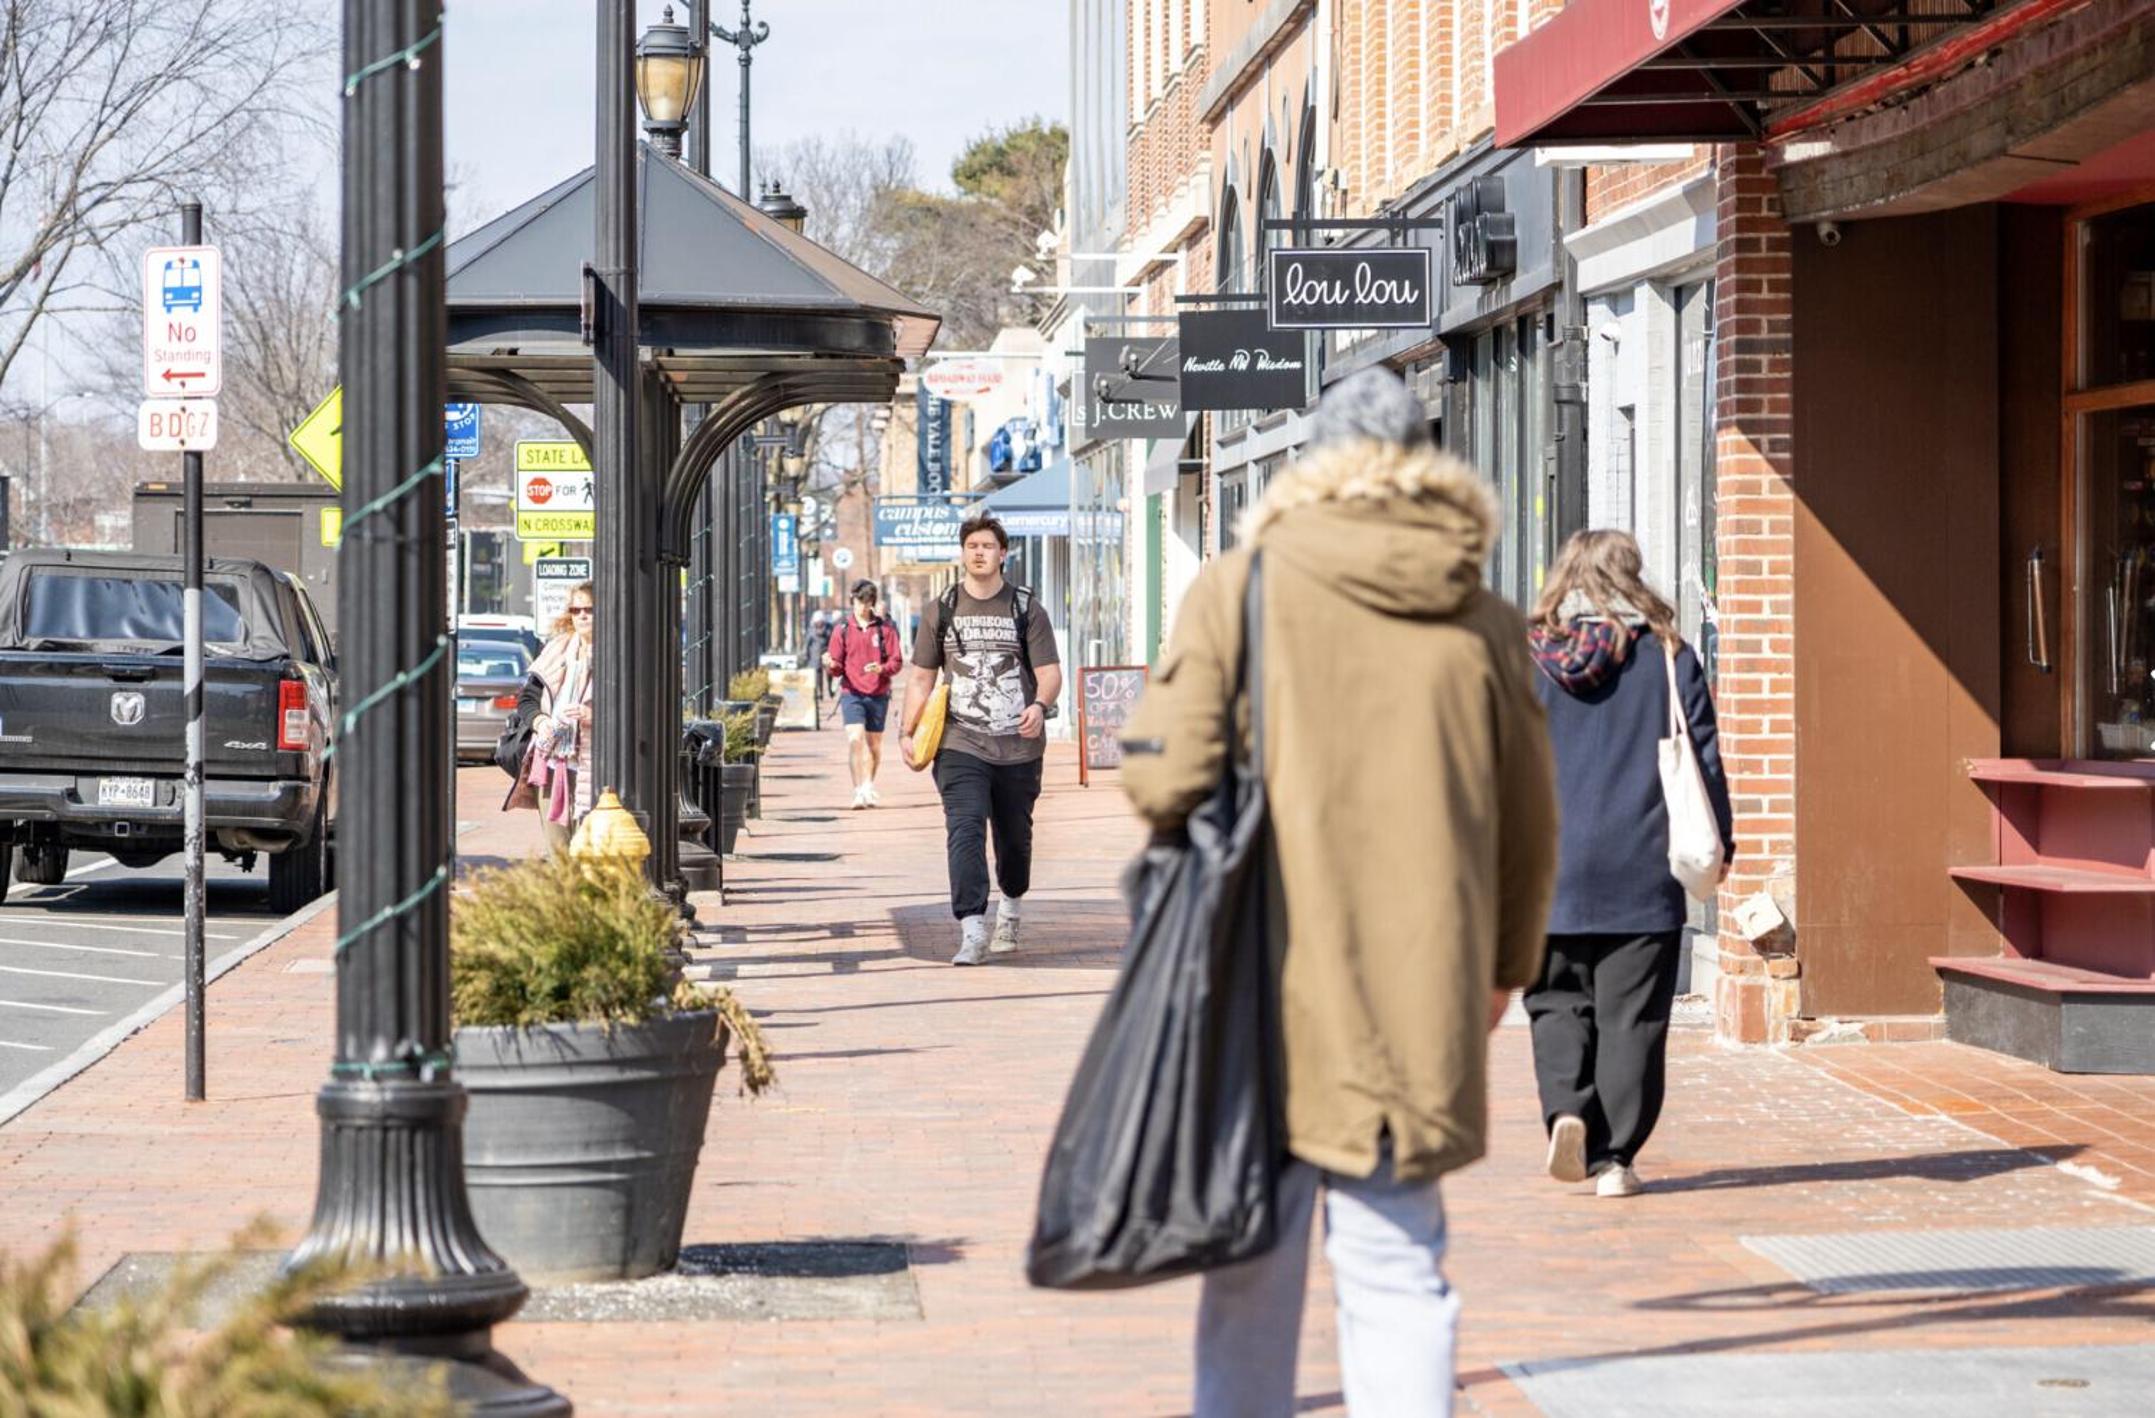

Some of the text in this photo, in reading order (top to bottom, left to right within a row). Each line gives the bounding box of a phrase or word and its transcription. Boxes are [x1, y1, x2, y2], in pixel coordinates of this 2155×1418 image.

[1283, 262, 1419, 305] lou lou
[168, 322, 197, 343] No
[154, 348, 211, 364] Standing
[1183, 355, 1226, 373] Neville
[1254, 349, 1303, 371] Wisdom
[1092, 401, 1178, 427] J.CREW
[928, 420, 941, 460] YALE
[526, 449, 565, 464] STATE
[527, 485, 577, 497] STOP FOR
[878, 507, 950, 524] campus
[520, 520, 531, 531] IN
[538, 564, 588, 576] LOADING ZONE
[1086, 672, 1139, 700] 50%
